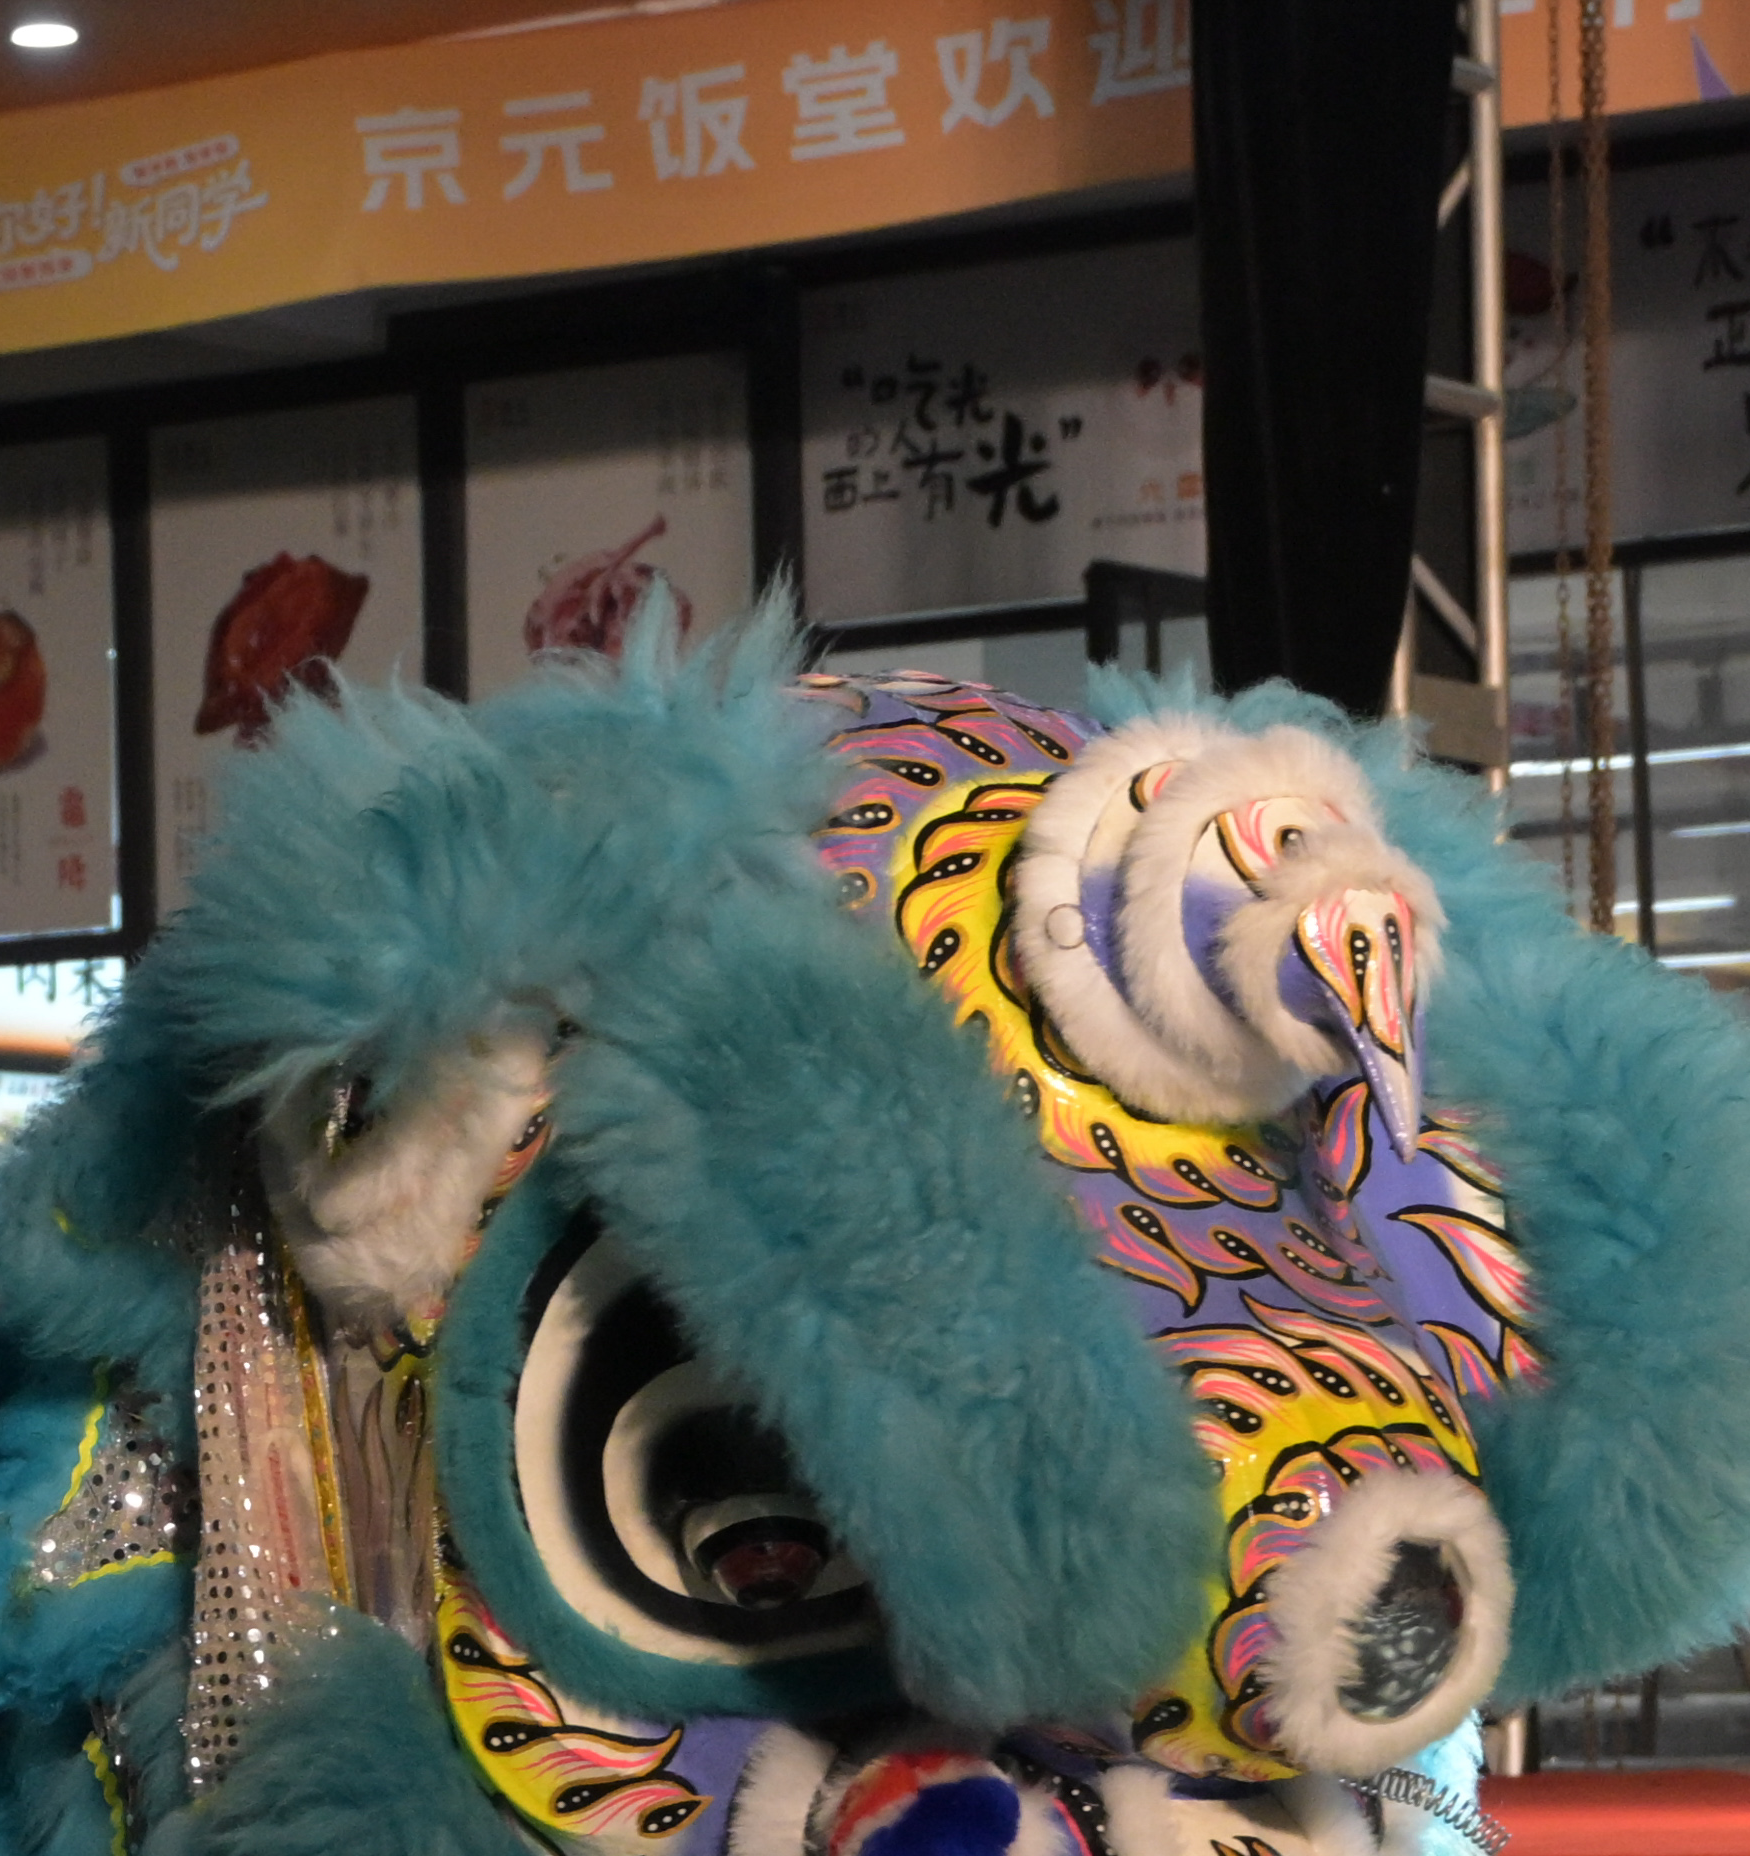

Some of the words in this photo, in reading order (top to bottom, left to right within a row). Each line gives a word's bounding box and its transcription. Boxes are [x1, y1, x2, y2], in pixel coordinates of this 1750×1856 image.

[354, 0, 1192, 212] 京元饭堂欢迎
